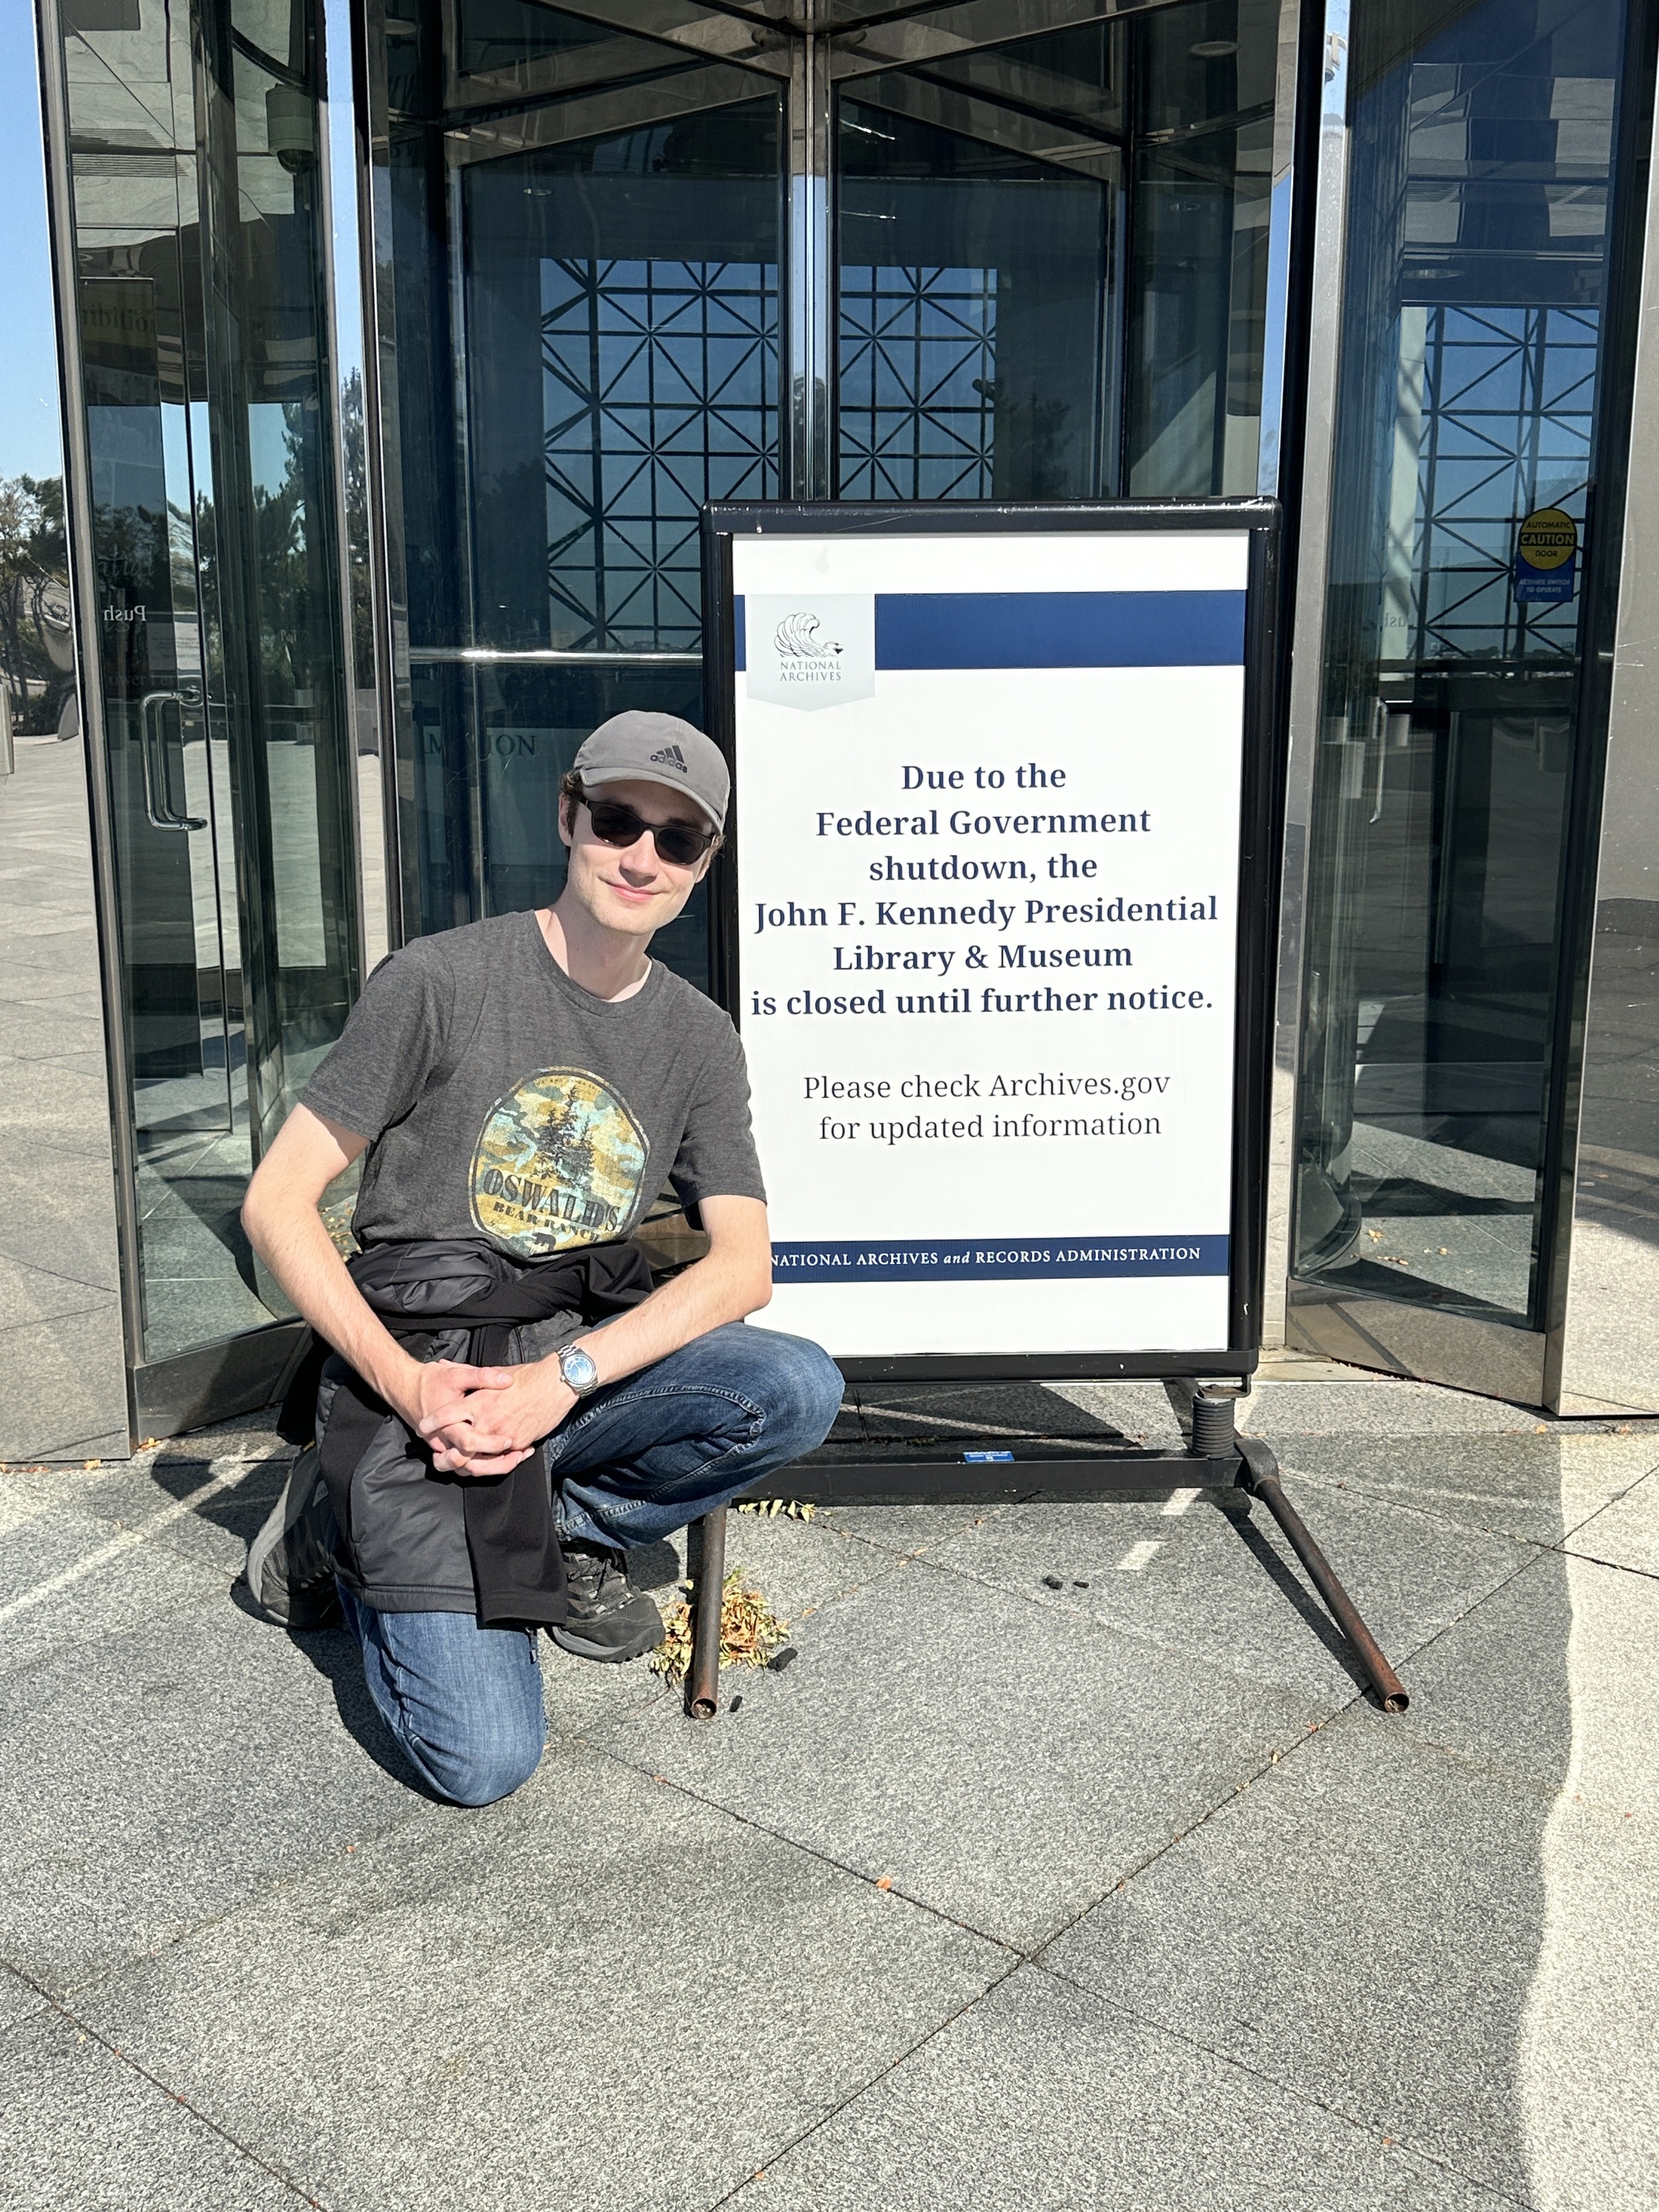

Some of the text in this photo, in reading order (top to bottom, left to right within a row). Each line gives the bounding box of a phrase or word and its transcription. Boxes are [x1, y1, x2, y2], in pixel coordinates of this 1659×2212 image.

[1520, 534, 1574, 545] CAUTION
[780, 661, 842, 670] NATIONAL
[780, 672, 842, 682] ARCHIVES
[649, 754, 688, 774] adidas
[901, 762, 1066, 790] Due to the
[816, 809, 1151, 836] Federal Government
[869, 853, 1097, 883] shutdown, the
[754, 895, 1218, 935] John F. Kennedy Presidential
[833, 945, 1133, 977] Library & Museum
[751, 984, 1212, 1015] is closed until further notice.
[804, 1072, 1170, 1101] Please check Archives.gov
[819, 1111, 1161, 1146] for updated information
[493, 1202, 601, 1242] BEAR RANCH
[771, 1247, 1201, 1266] NATIONAL ARCHIVES and RECORDS ADMINISTRATION
